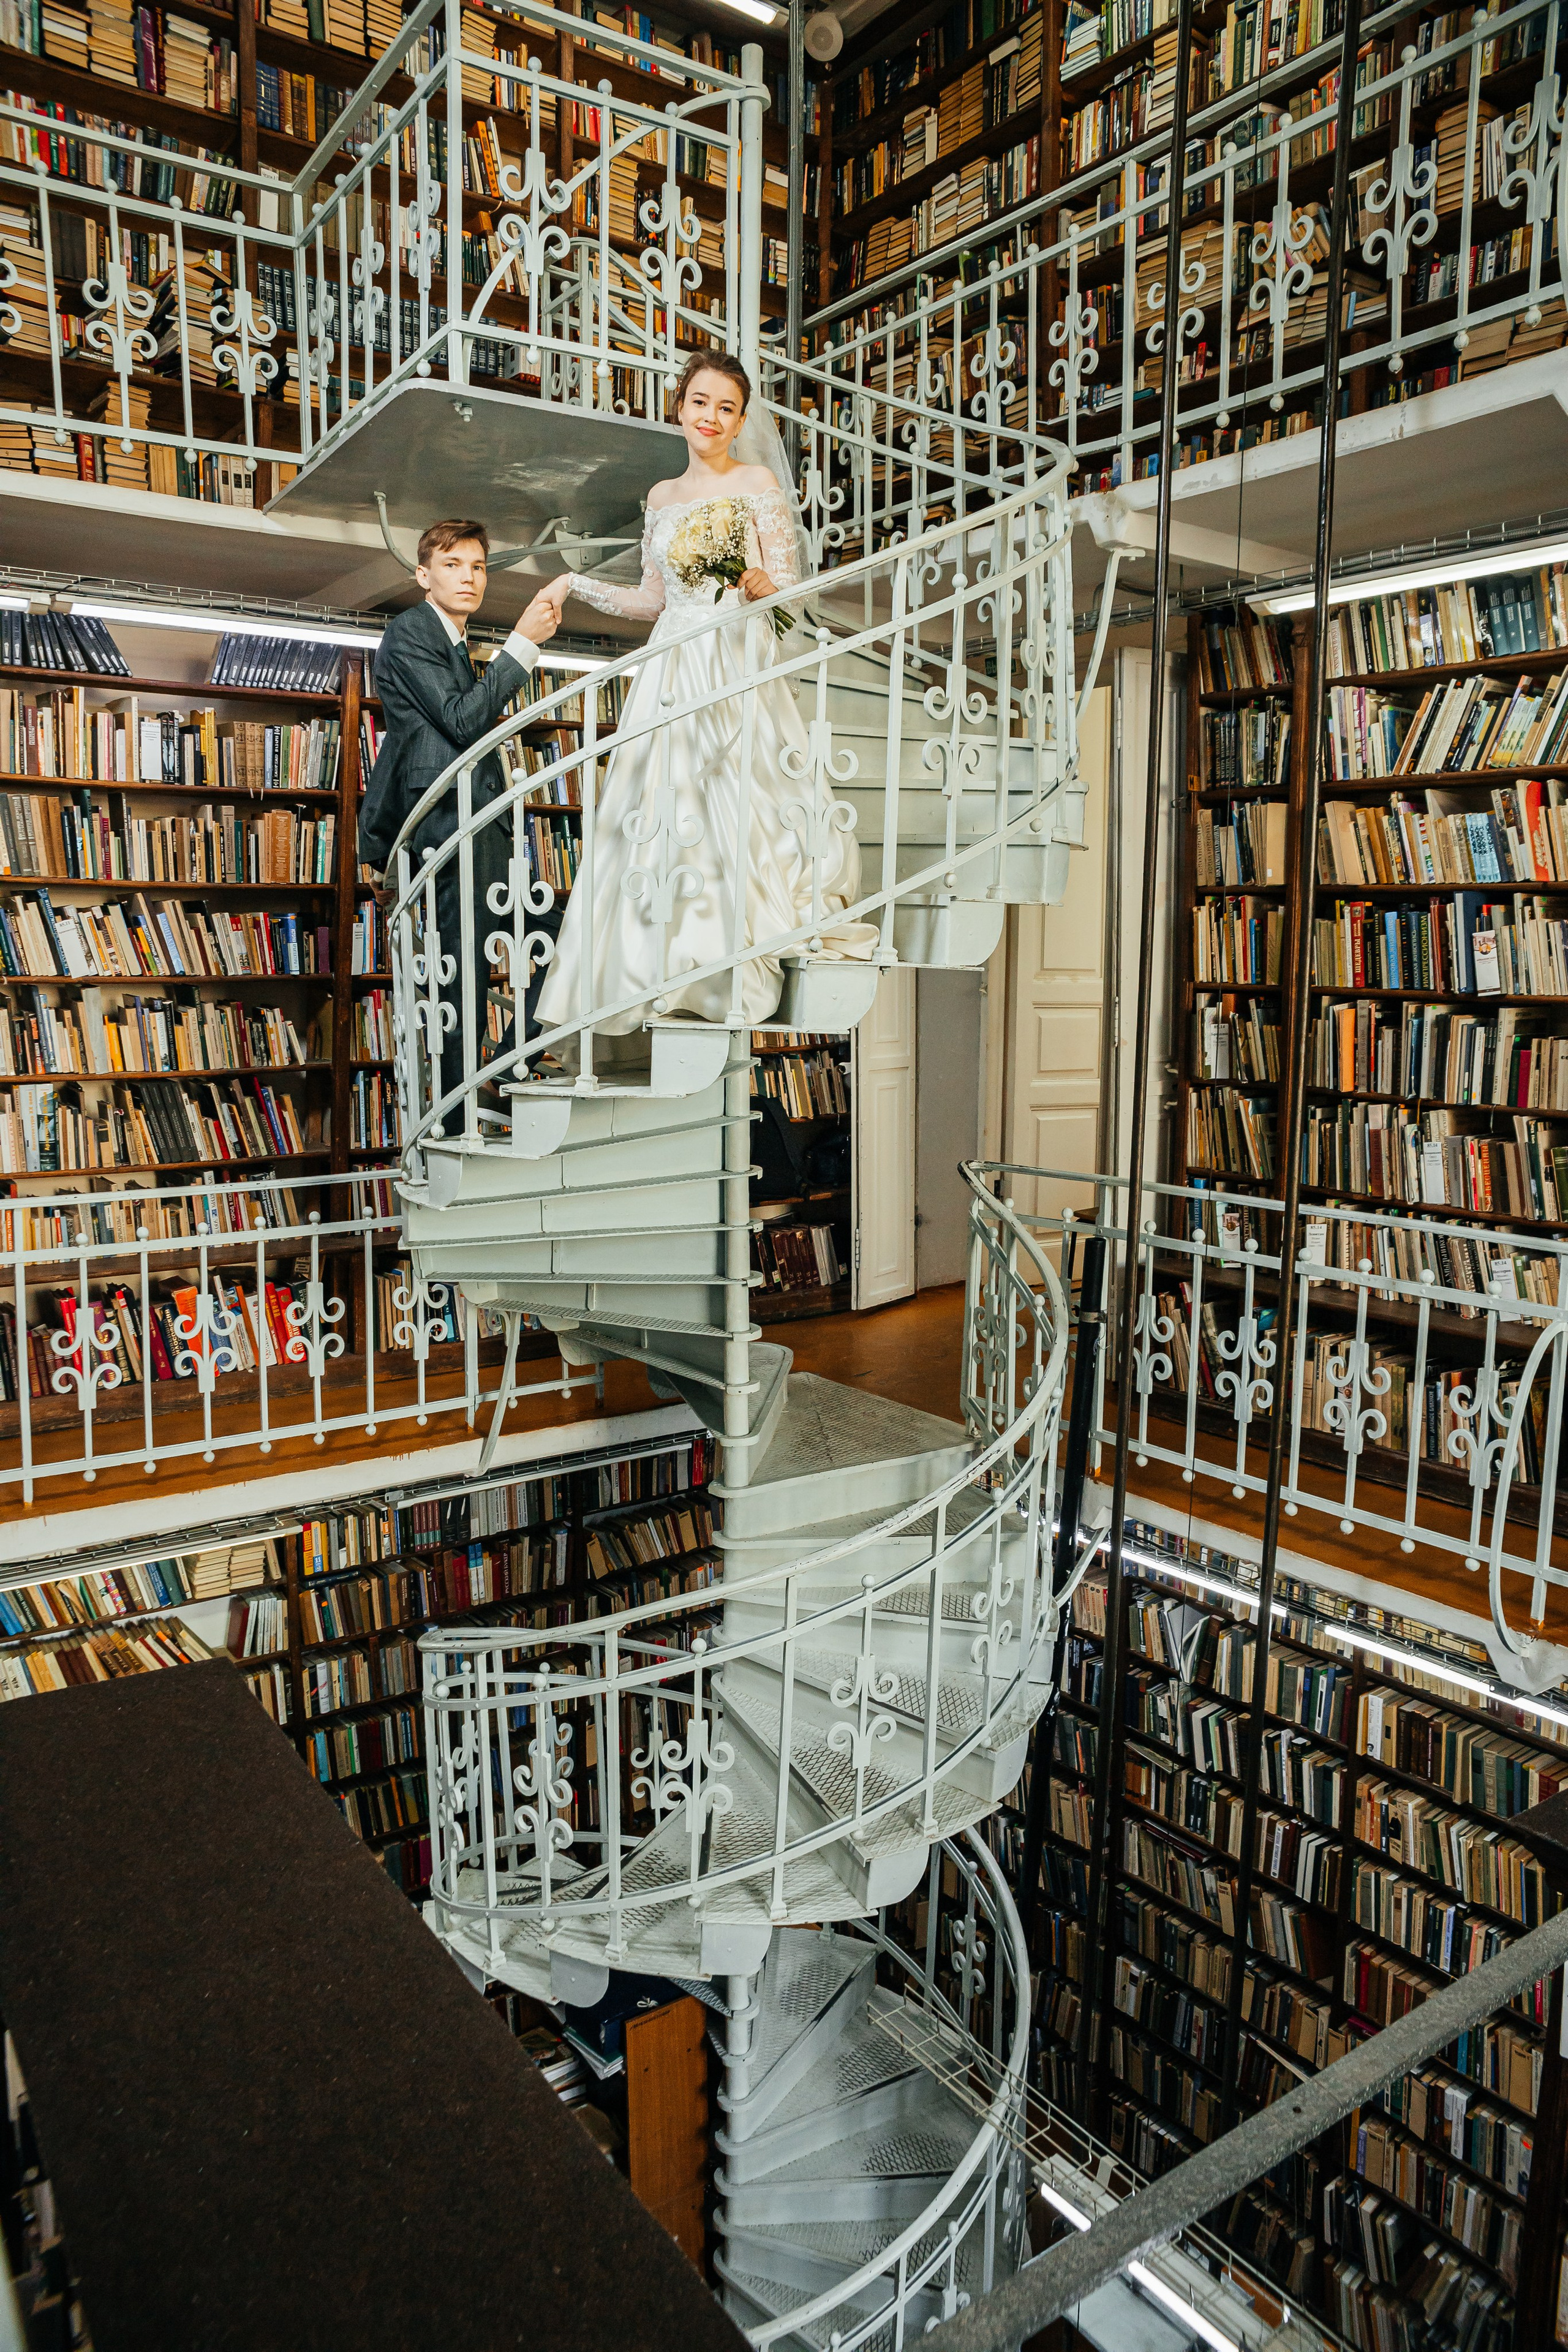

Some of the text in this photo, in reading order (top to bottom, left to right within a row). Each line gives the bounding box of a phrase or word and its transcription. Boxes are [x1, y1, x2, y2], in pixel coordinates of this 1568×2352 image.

[1476, 249, 1484, 285] Елтышевы
[161, 913, 178, 956] АРХИТЕКТУРА
[165, 1309, 179, 1354] ИЛОСОФСКИЙ
